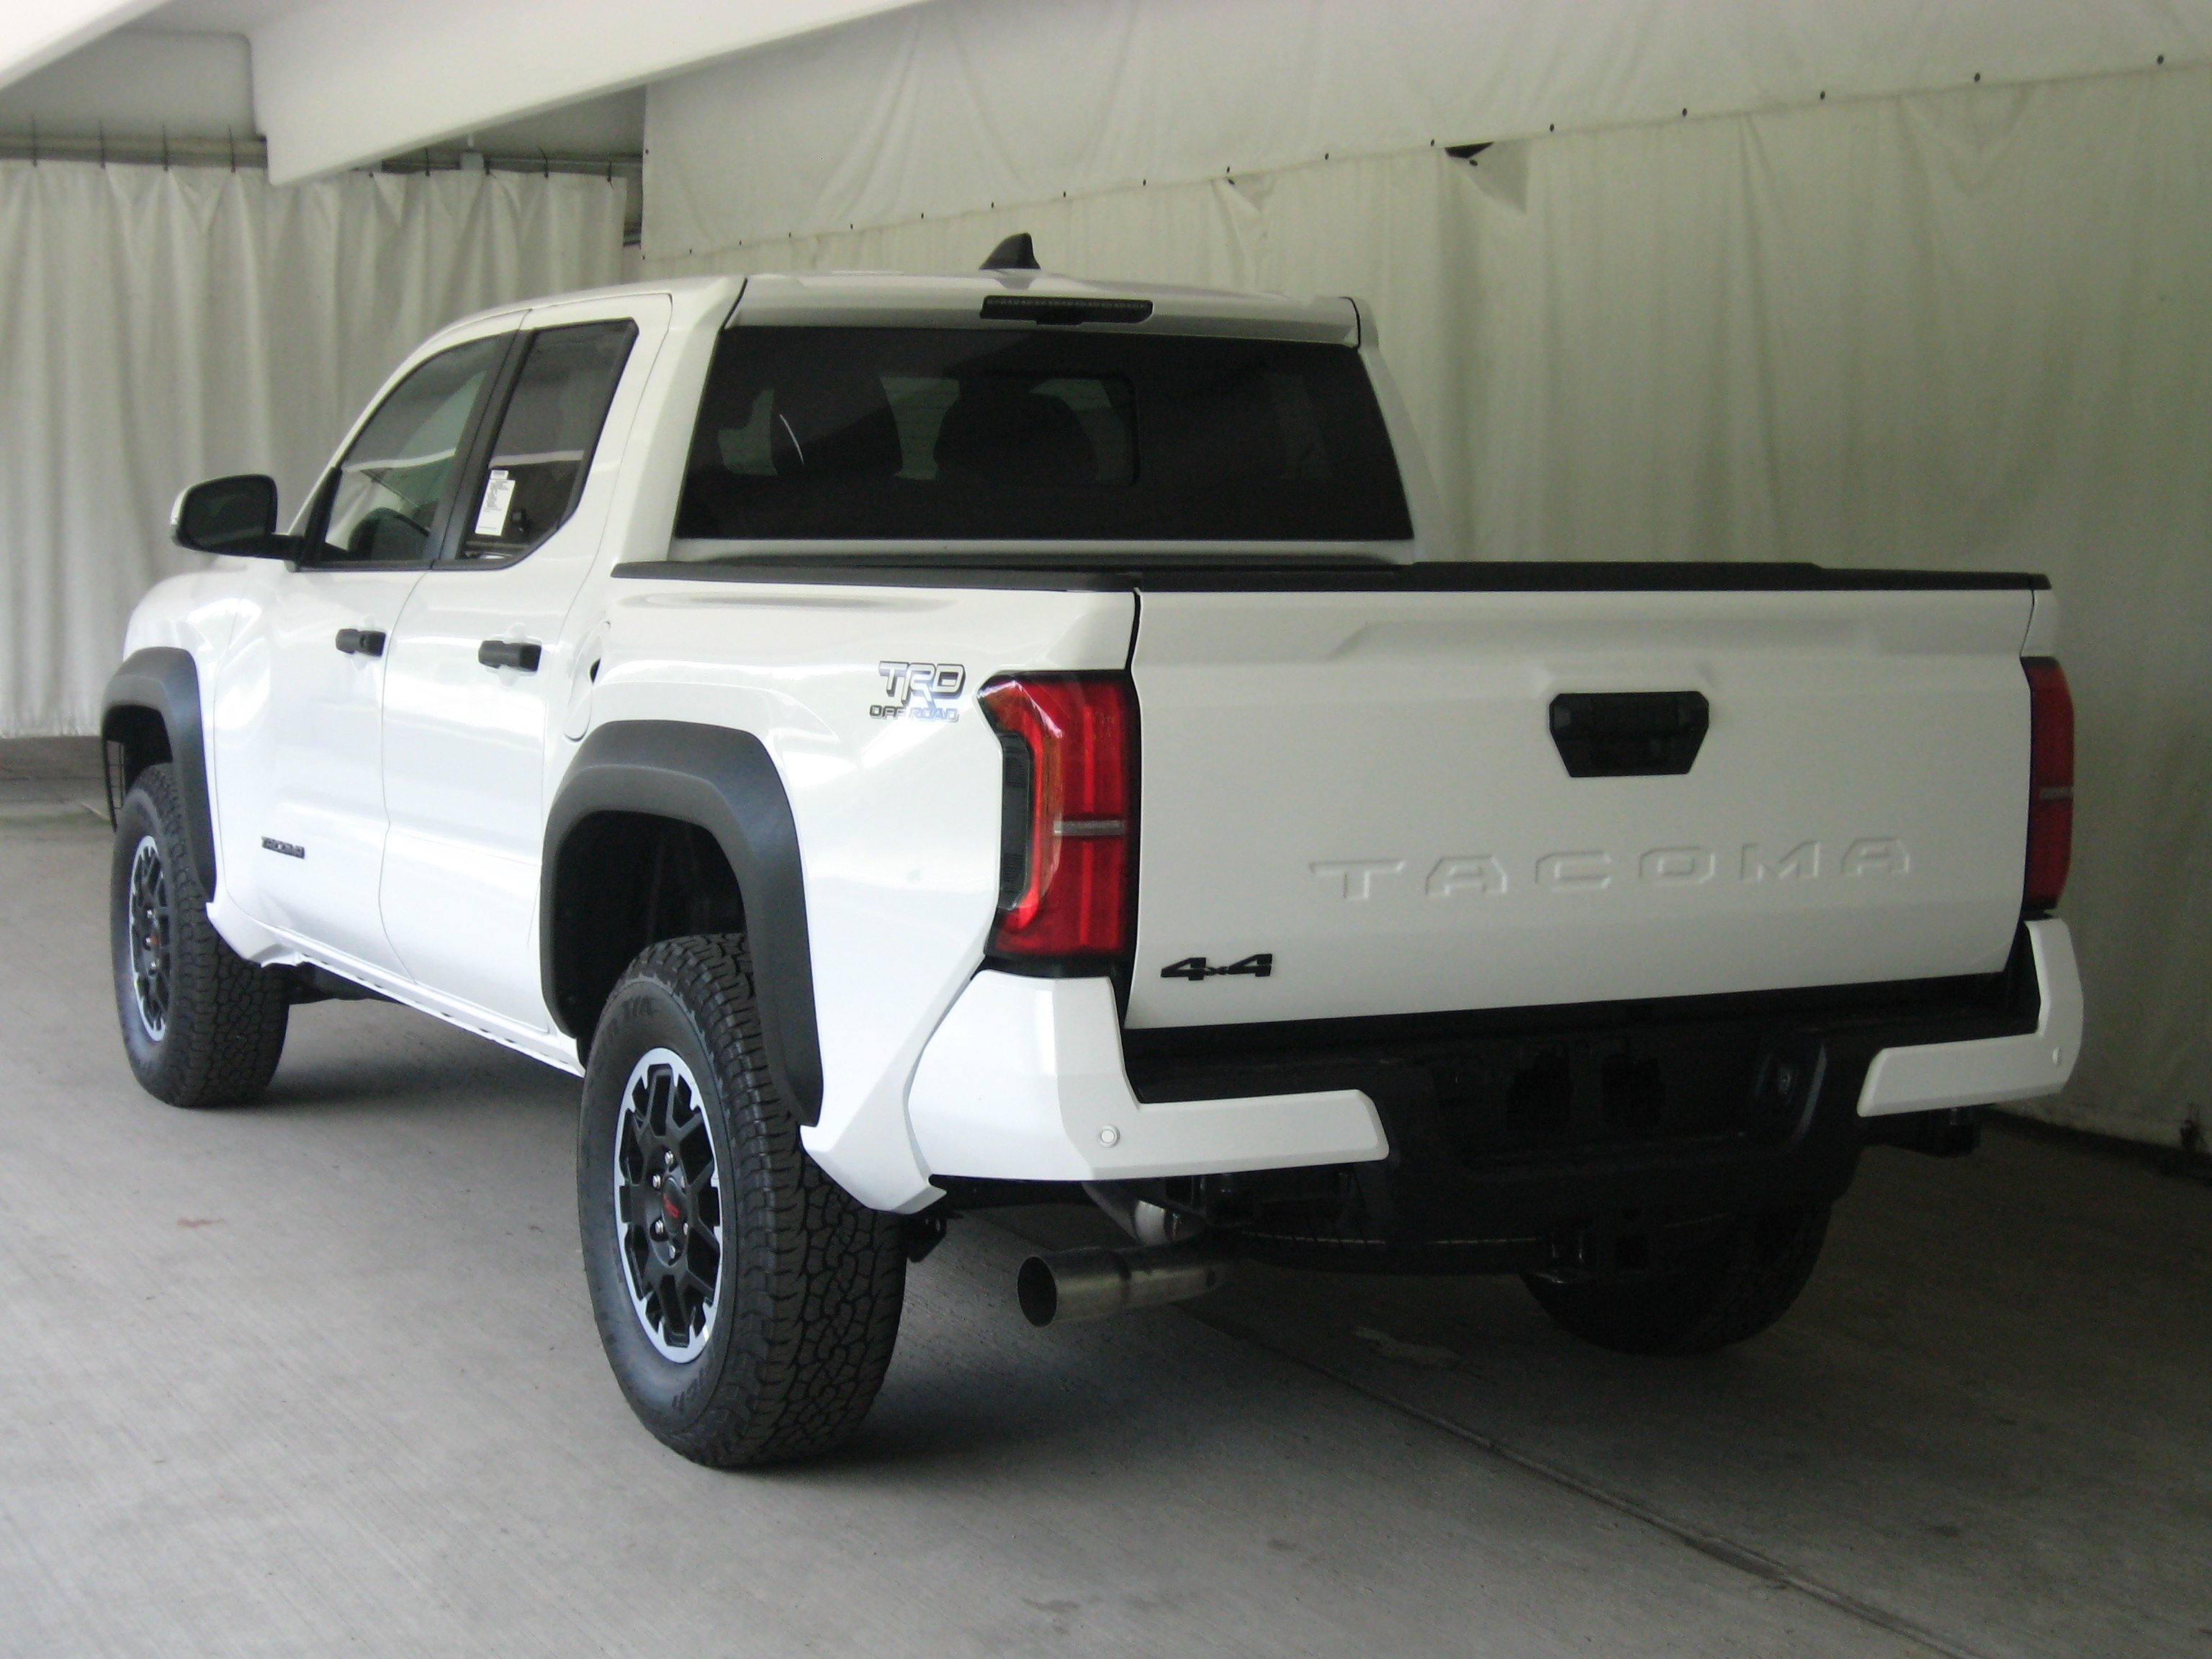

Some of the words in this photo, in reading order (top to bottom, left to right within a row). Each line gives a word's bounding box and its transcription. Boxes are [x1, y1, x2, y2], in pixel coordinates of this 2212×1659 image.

[878, 660, 966, 708] TRD
[869, 705, 905, 720] OFF
[909, 706, 959, 722] ROAD
[1309, 837, 1911, 902] TACOMA
